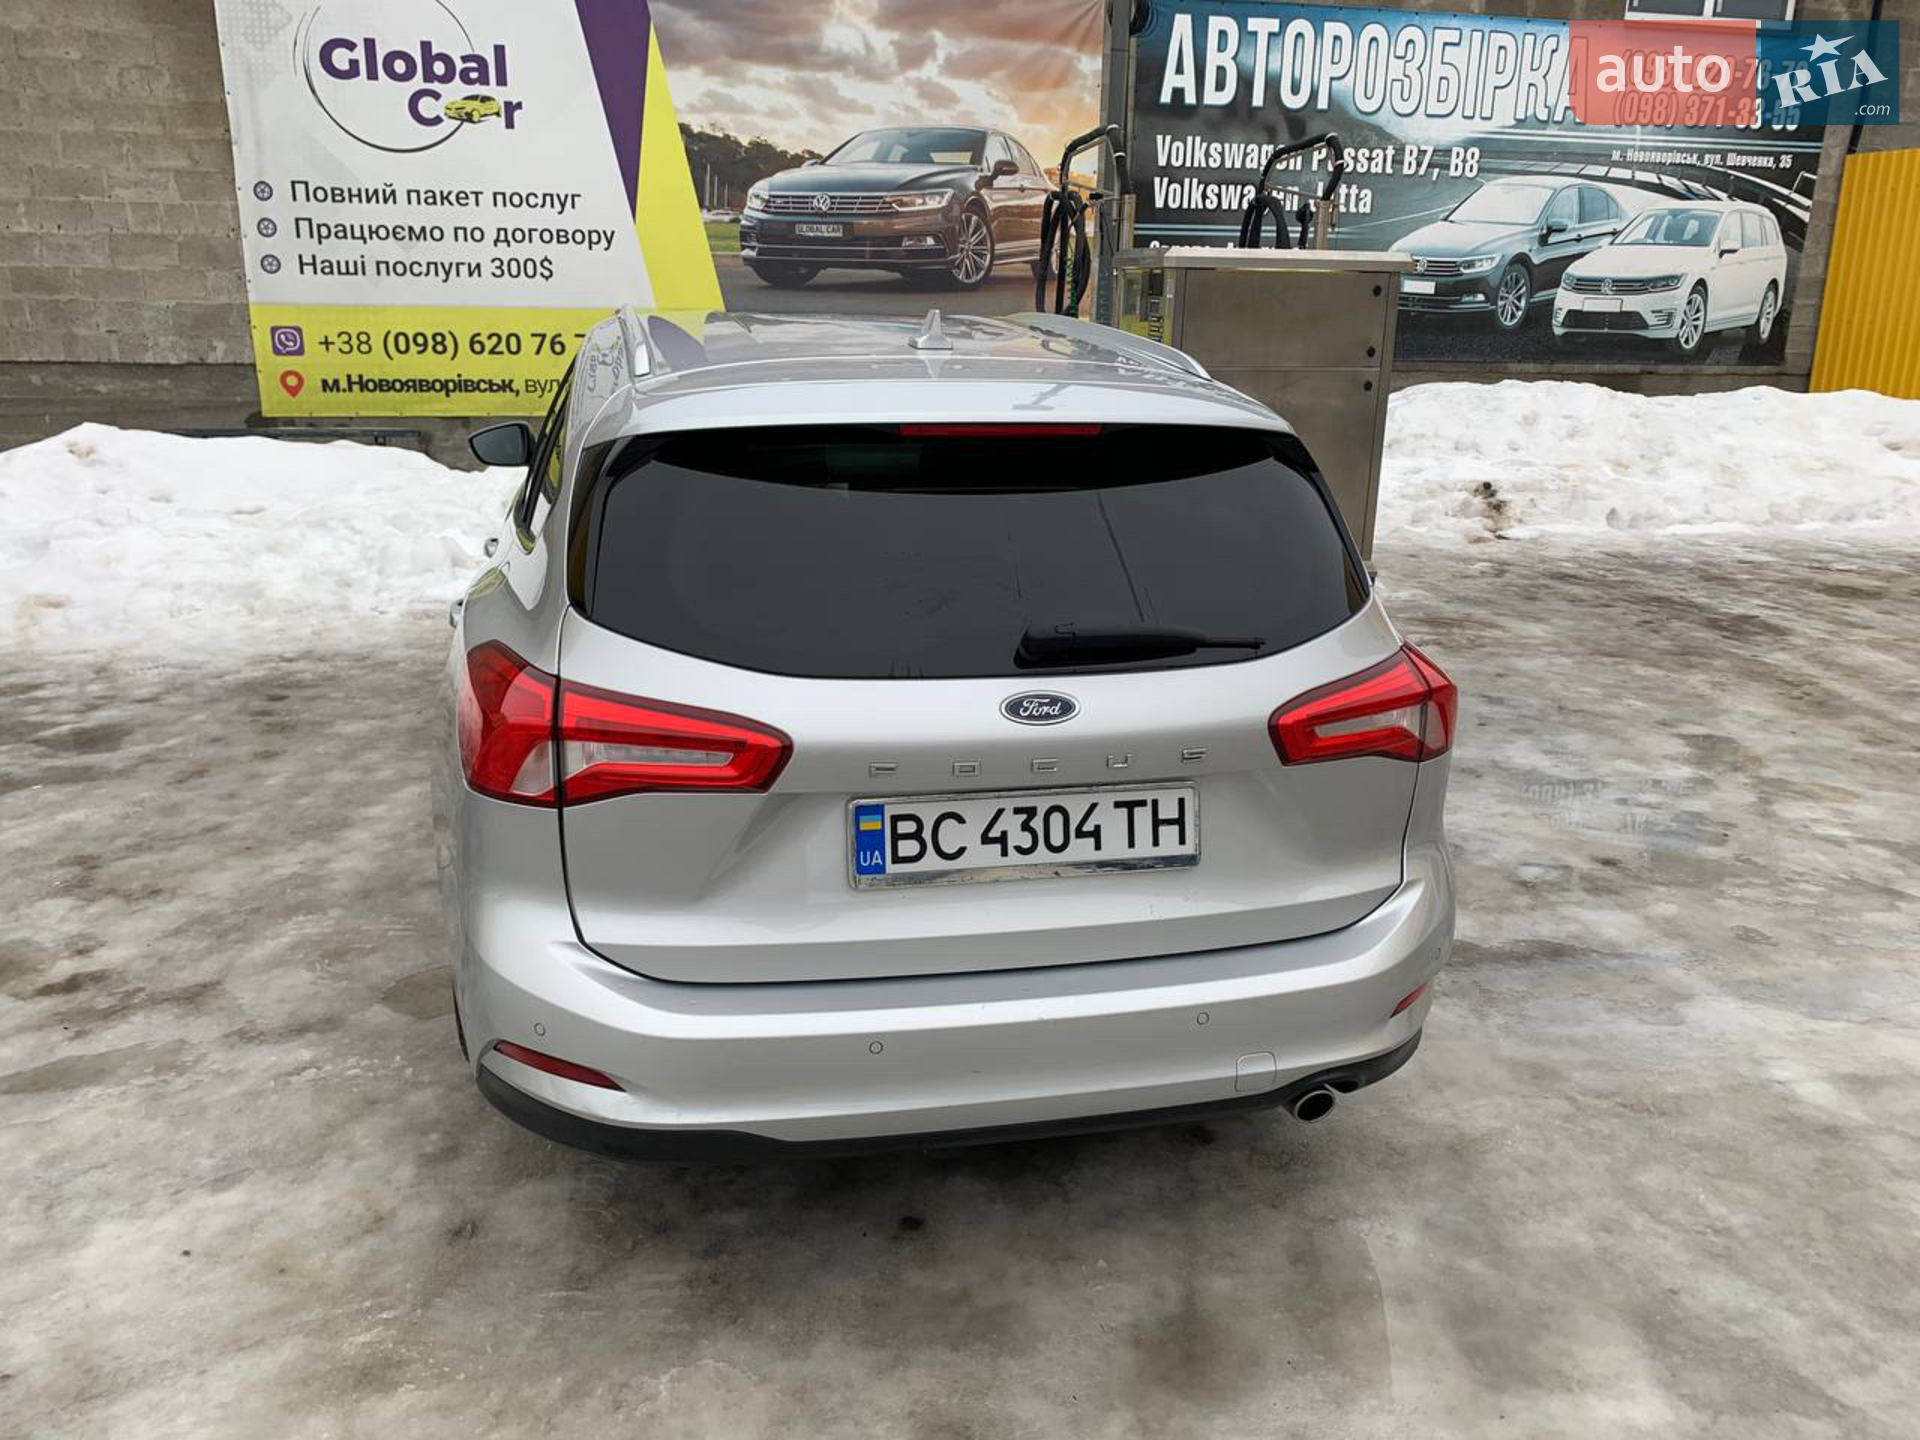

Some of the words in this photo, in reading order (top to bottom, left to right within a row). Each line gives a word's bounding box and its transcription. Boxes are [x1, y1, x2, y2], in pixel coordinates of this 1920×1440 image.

[318, 37, 508, 87] Global
[1159, 13, 1589, 124] АВТОРОЗБІРКА
[407, 88, 523, 130] Cr
[1311, 145, 1395, 175] Pssat
[1403, 144, 1440, 180] B7,
[1450, 146, 1480, 178] B8
[290, 180, 397, 205] Повний
[406, 189, 484, 207] пакет
[492, 191, 582, 215] послуг
[1153, 177, 1299, 214] Volkswaen
[1308, 181, 1373, 214] Jtta
[294, 217, 444, 245] Працюємо
[454, 226, 485, 243] по
[493, 227, 615, 251] договору
[298, 254, 367, 276] Наші
[375, 260, 482, 283] послуги
[490, 255, 554, 282] 300$
[318, 331, 373, 355] +38
[383, 330, 459, 361] (098)
[469, 332, 522, 356] 620
[530, 333, 566, 356] 76
[321, 373, 520, 398] м.Новояворівськ,
[1018, 697, 1063, 718] Ford
[868, 746, 1208, 778] FOCUS
[859, 850, 883, 867] UA
[890, 811, 967, 865] BC
[980, 801, 1102, 858] 4304
[1113, 797, 1186, 850] TH
